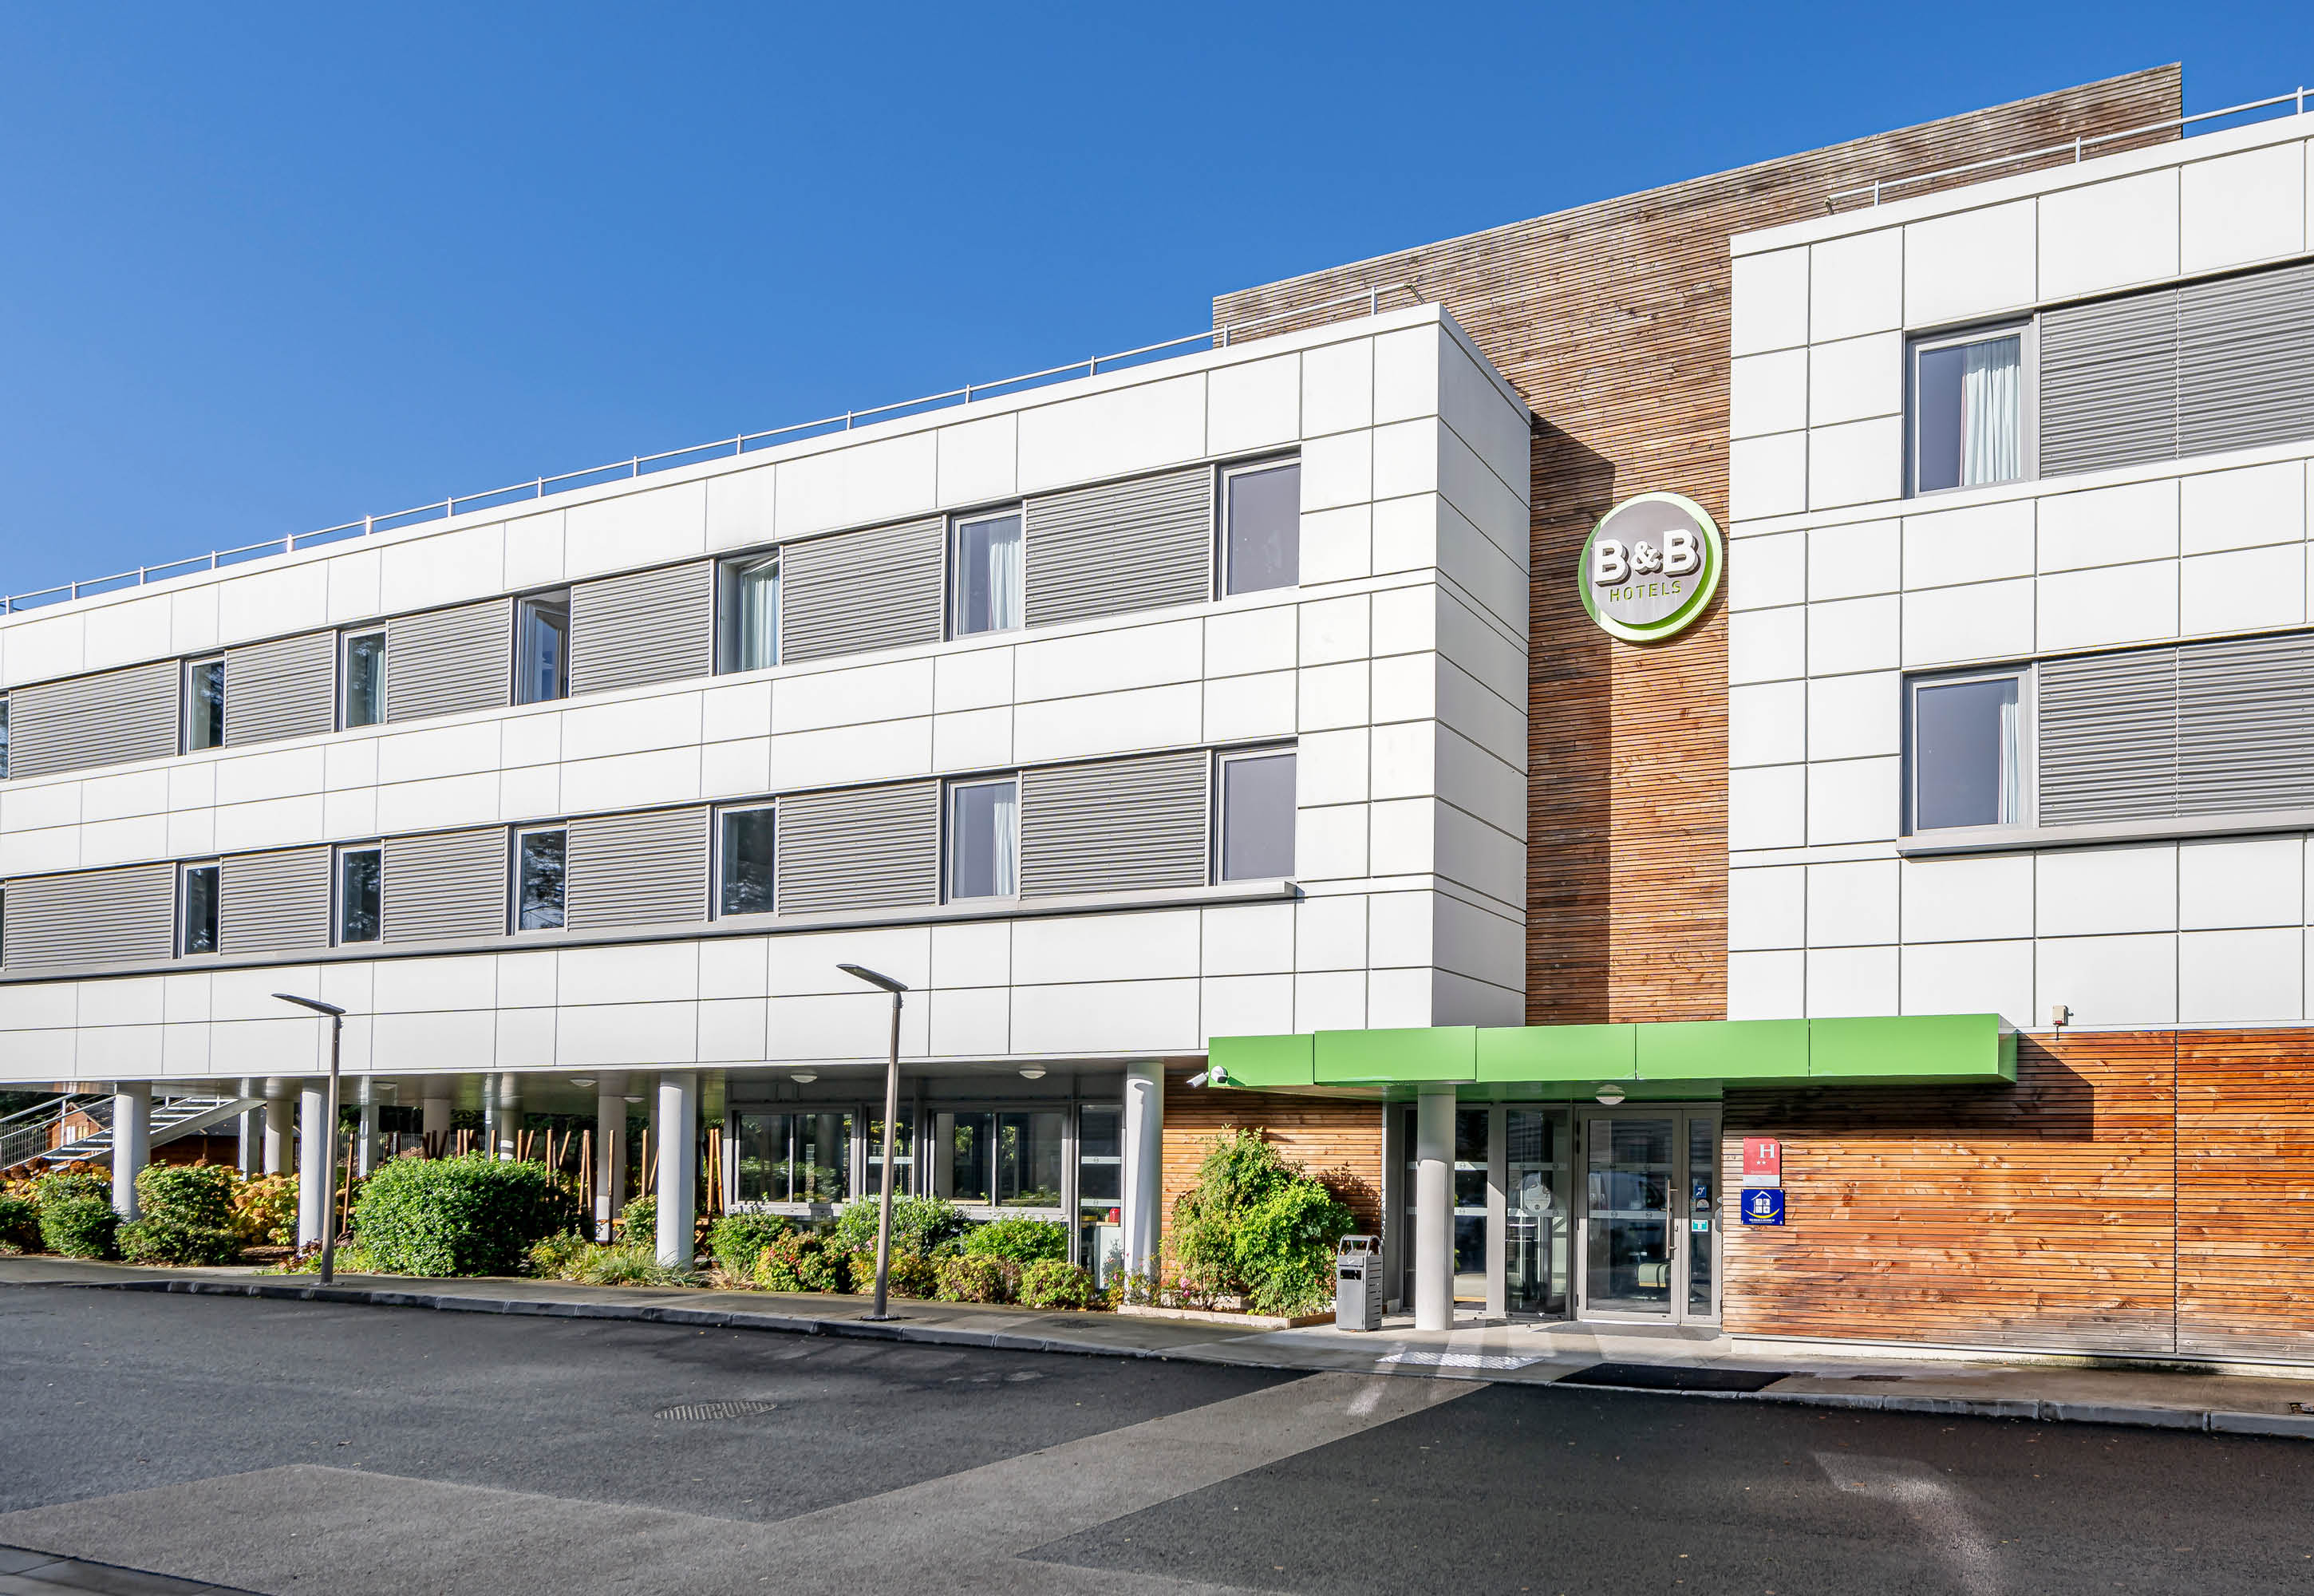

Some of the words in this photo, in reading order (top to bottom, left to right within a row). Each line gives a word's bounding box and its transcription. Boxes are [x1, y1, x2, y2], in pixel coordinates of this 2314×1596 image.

[1593, 529, 1700, 585] B&B
[1609, 580, 1682, 602] HOTELS
[1759, 1143, 1775, 1159] H
